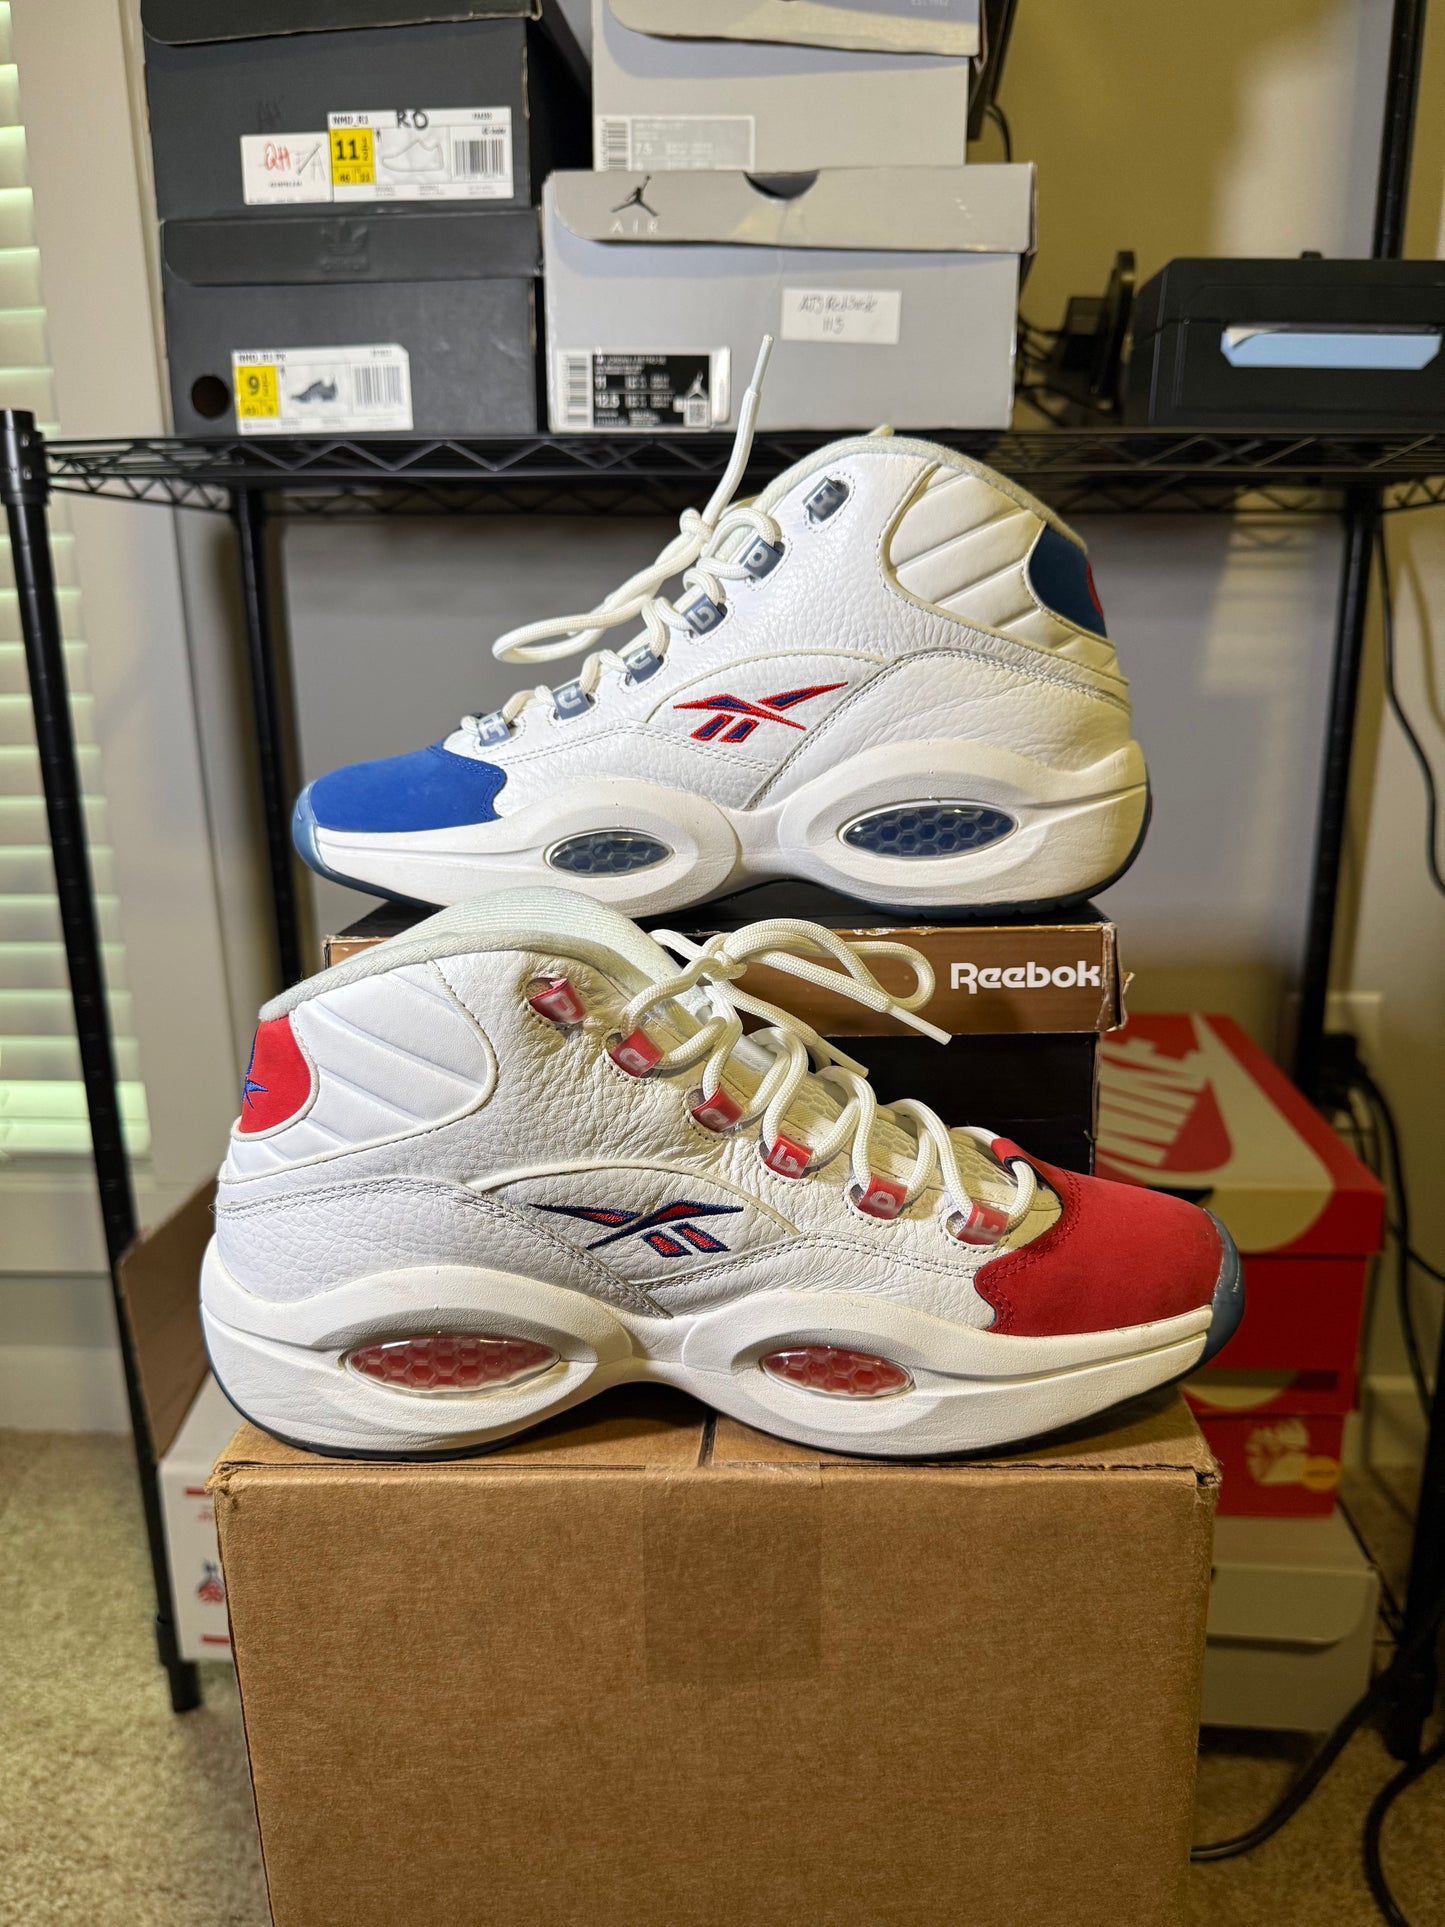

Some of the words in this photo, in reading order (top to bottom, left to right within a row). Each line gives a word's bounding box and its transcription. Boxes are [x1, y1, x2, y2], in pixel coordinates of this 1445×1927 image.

[336, 139, 359, 161] 11
[610, 219, 660, 234] AIR
[248, 375, 260, 396] 9
[950, 960, 1101, 994] Reebok
